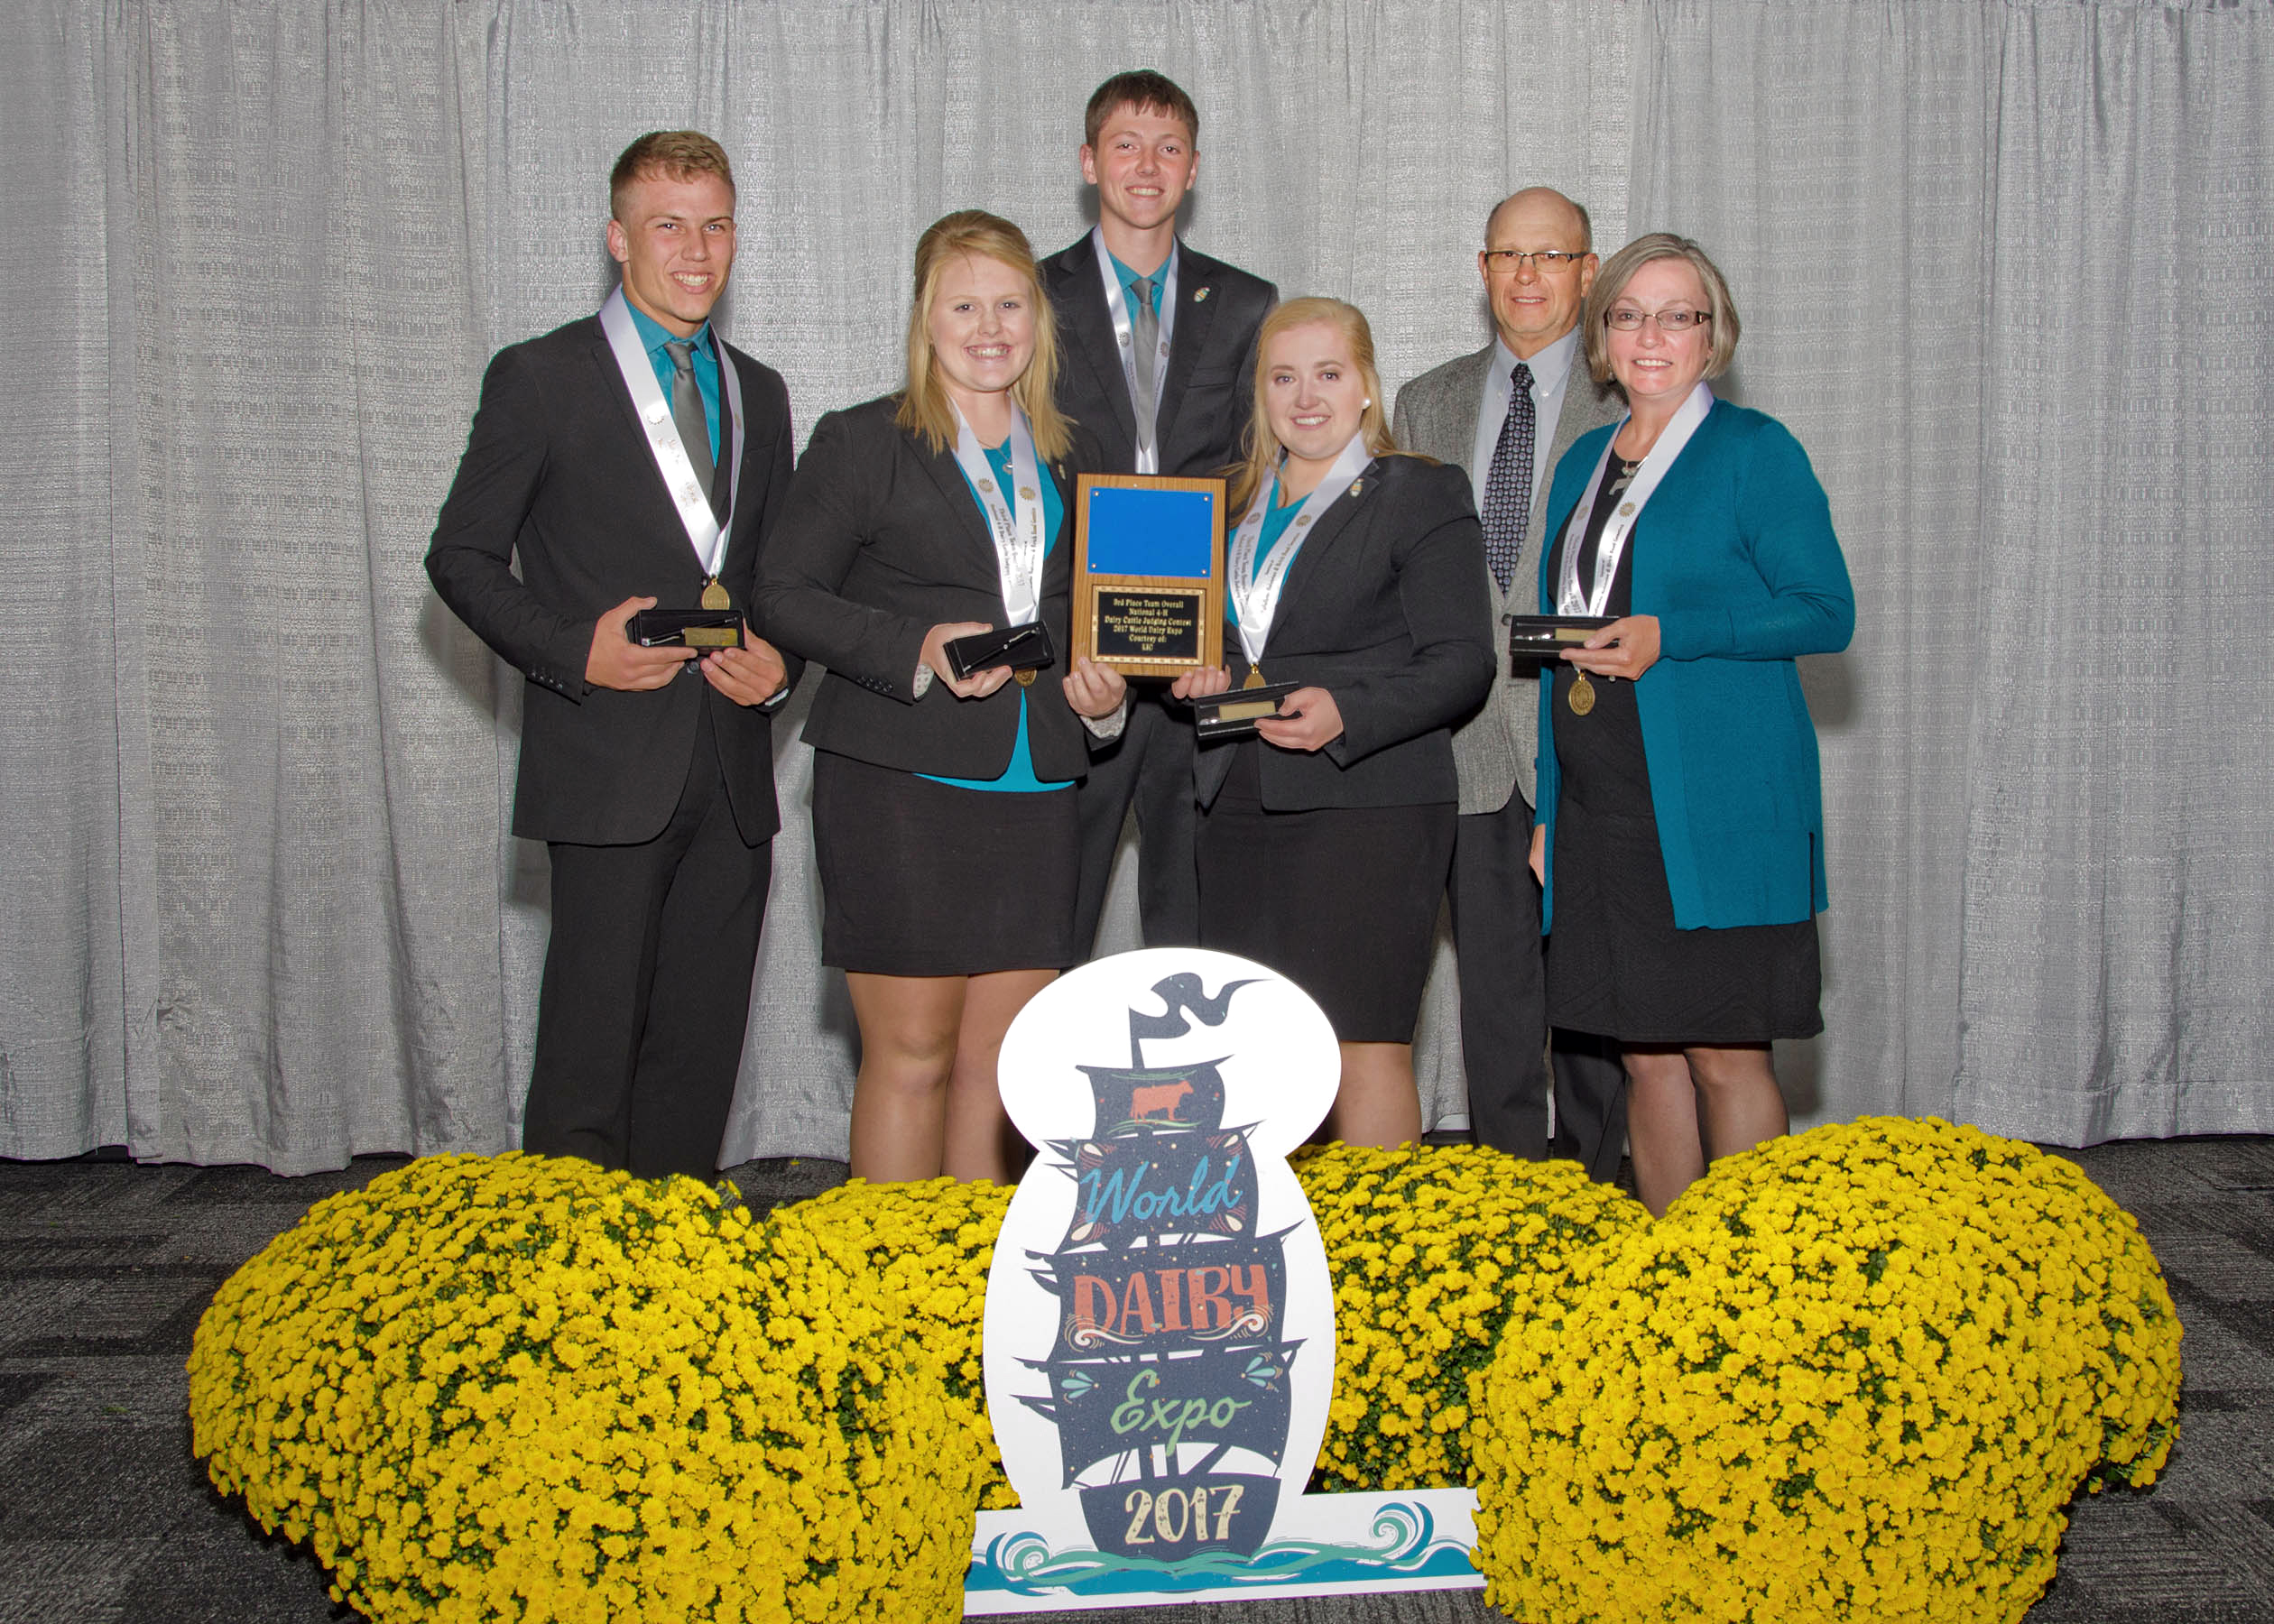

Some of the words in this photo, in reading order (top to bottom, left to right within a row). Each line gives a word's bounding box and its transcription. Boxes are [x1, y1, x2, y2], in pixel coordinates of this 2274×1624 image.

[1113, 598, 1124, 606] 3rd
[1125, 598, 1142, 607] Place
[1143, 599, 1160, 607] Team
[1161, 600, 1184, 609] Overall
[1129, 607, 1155, 616] National
[1156, 609, 1169, 617] 4-H
[1105, 615, 1122, 624] Dairy
[1123, 616, 1142, 624] Cattle
[1142, 617, 1167, 626] Judging
[1168, 618, 1192, 627] Contest
[1113, 624, 1128, 632] 2017
[1129, 625, 1148, 633] World
[1148, 626, 1166, 635] Dairy
[1167, 627, 1183, 636] Expo
[1129, 633, 1157, 643] Courtesy
[1080, 1155, 1243, 1223] World
[1074, 1264, 1269, 1337] DAIRY
[1110, 1369, 1253, 1457] Expo
[1124, 1484, 1244, 1545] 2017
